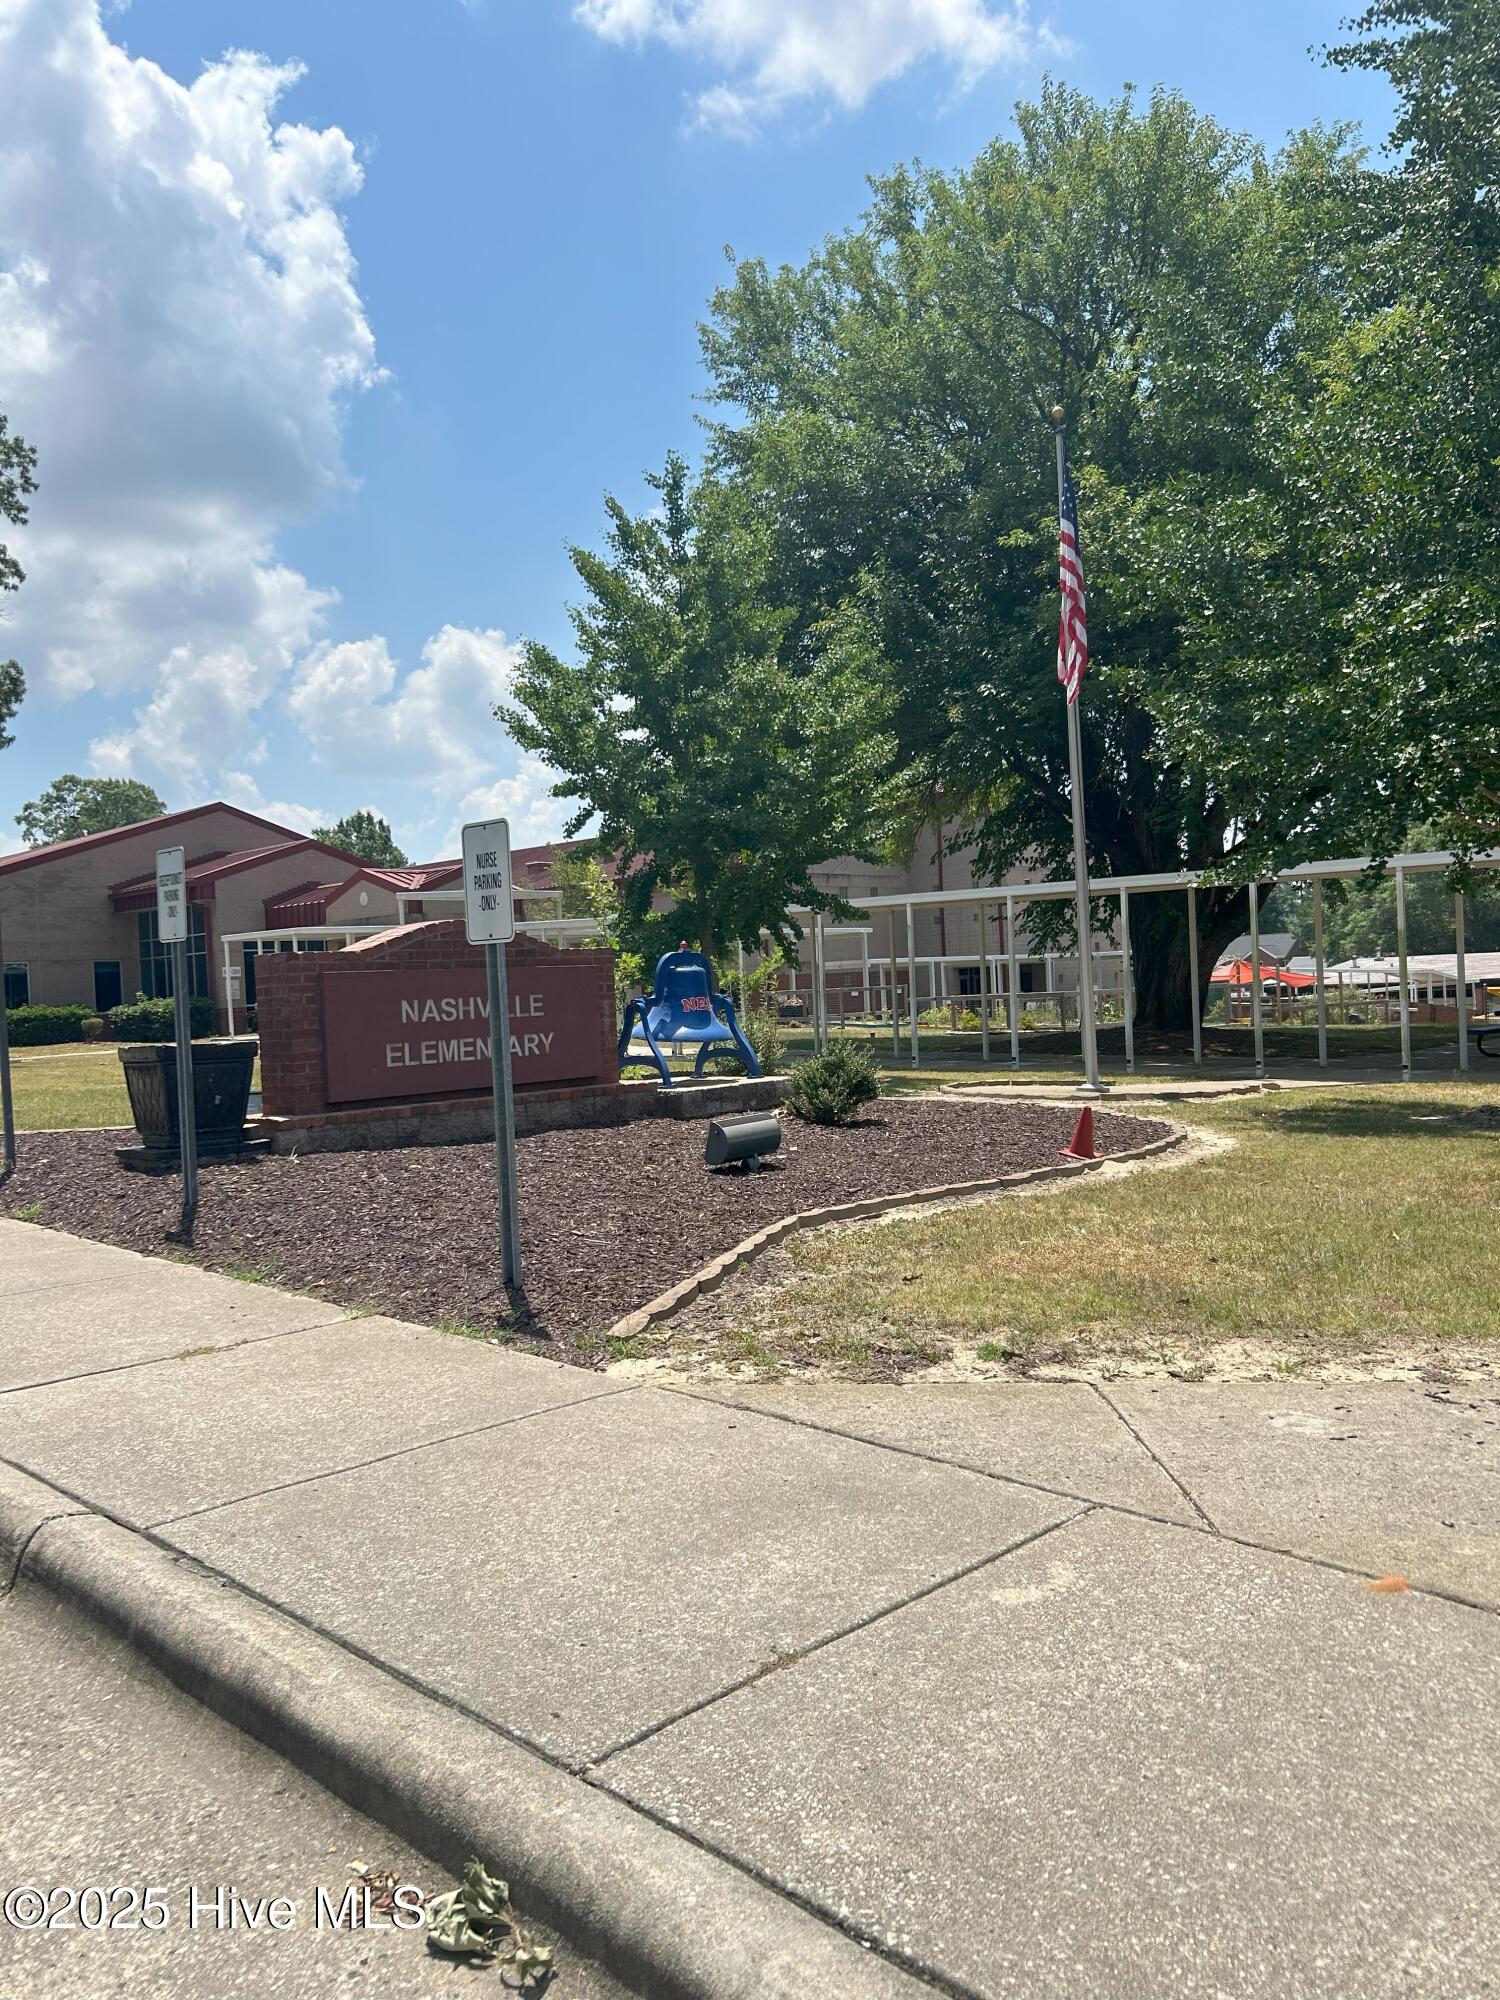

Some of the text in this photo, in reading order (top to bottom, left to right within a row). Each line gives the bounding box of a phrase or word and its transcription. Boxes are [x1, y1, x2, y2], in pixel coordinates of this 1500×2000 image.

[476, 851, 498, 870] NURSE
[474, 872, 502, 891] PARKING
[401, 994, 545, 1024] NASHVLE
[386, 1032, 555, 1068] ELEMENARY
